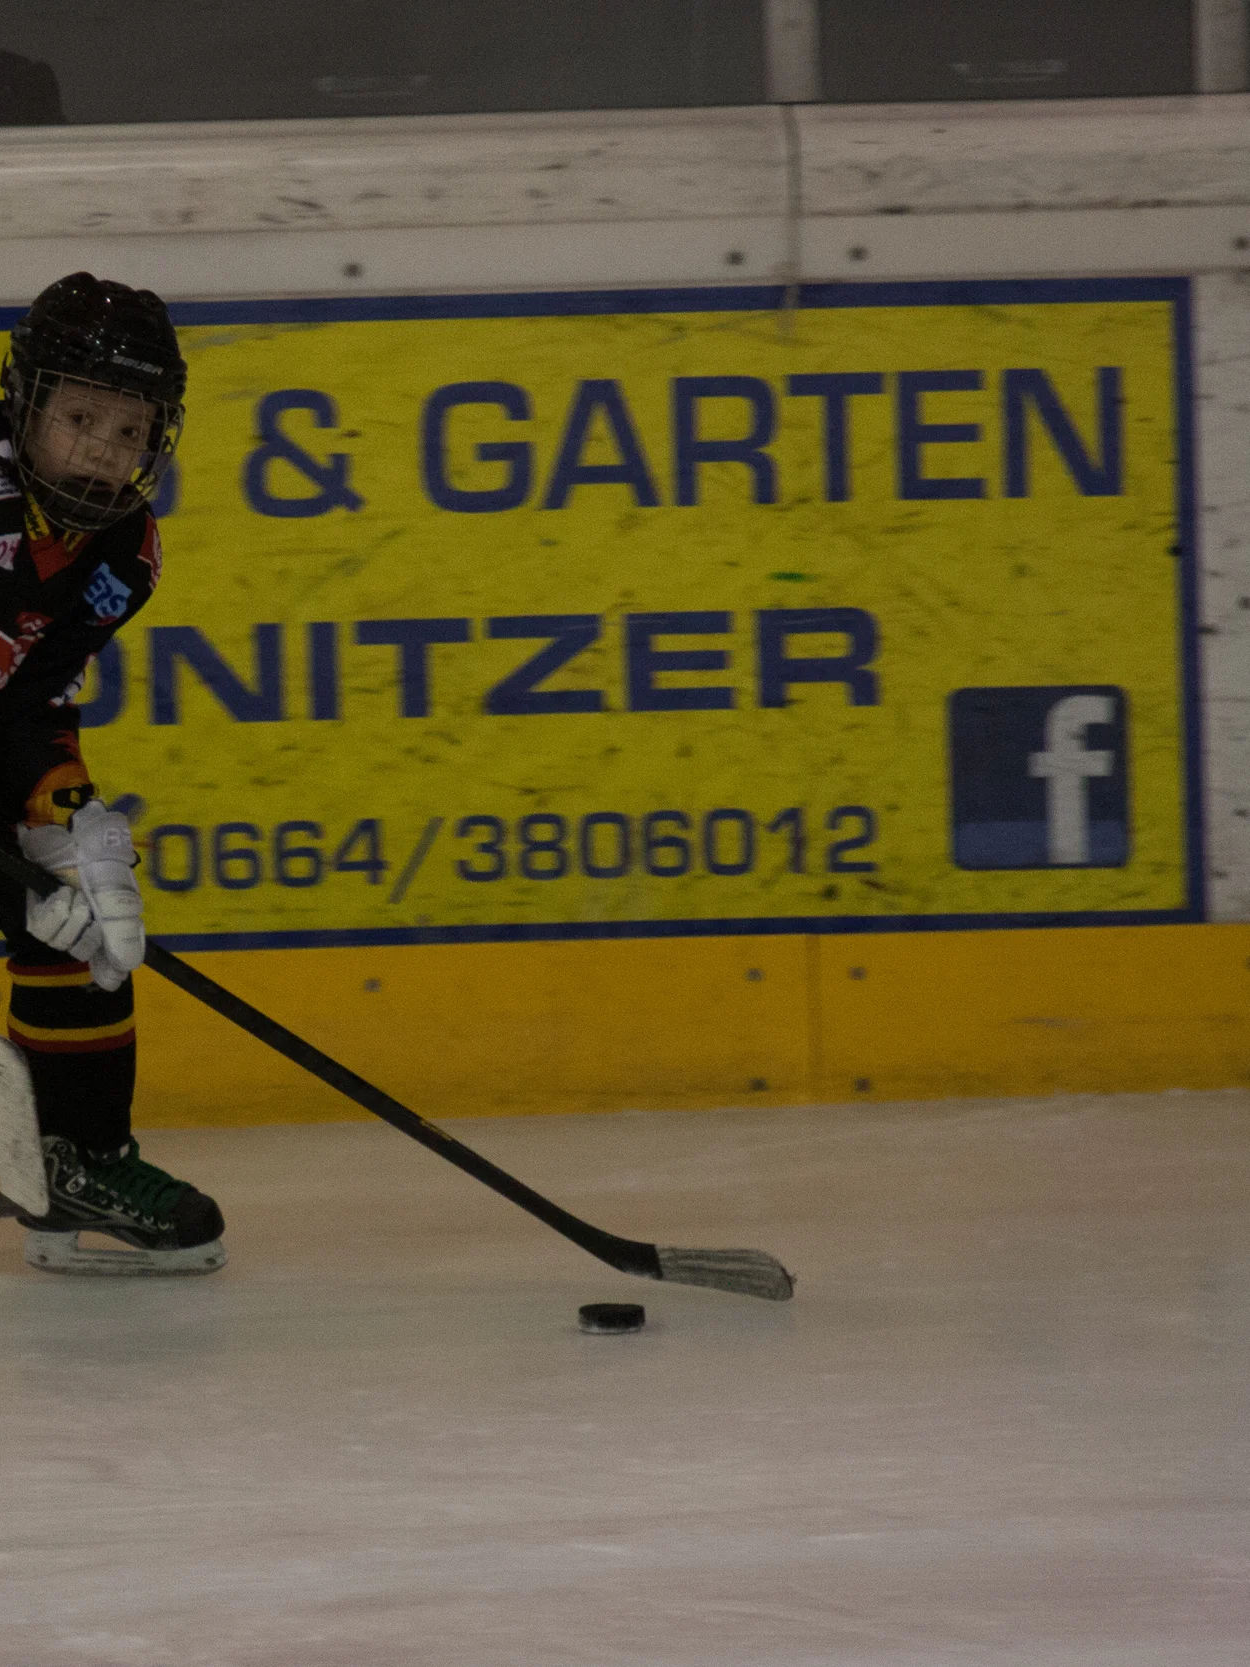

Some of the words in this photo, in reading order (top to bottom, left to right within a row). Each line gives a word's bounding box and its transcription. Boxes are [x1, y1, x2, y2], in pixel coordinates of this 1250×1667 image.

[241, 388, 364, 519] &
[419, 366, 1125, 515] GARTEN
[150, 804, 880, 905] 0664/3806012
